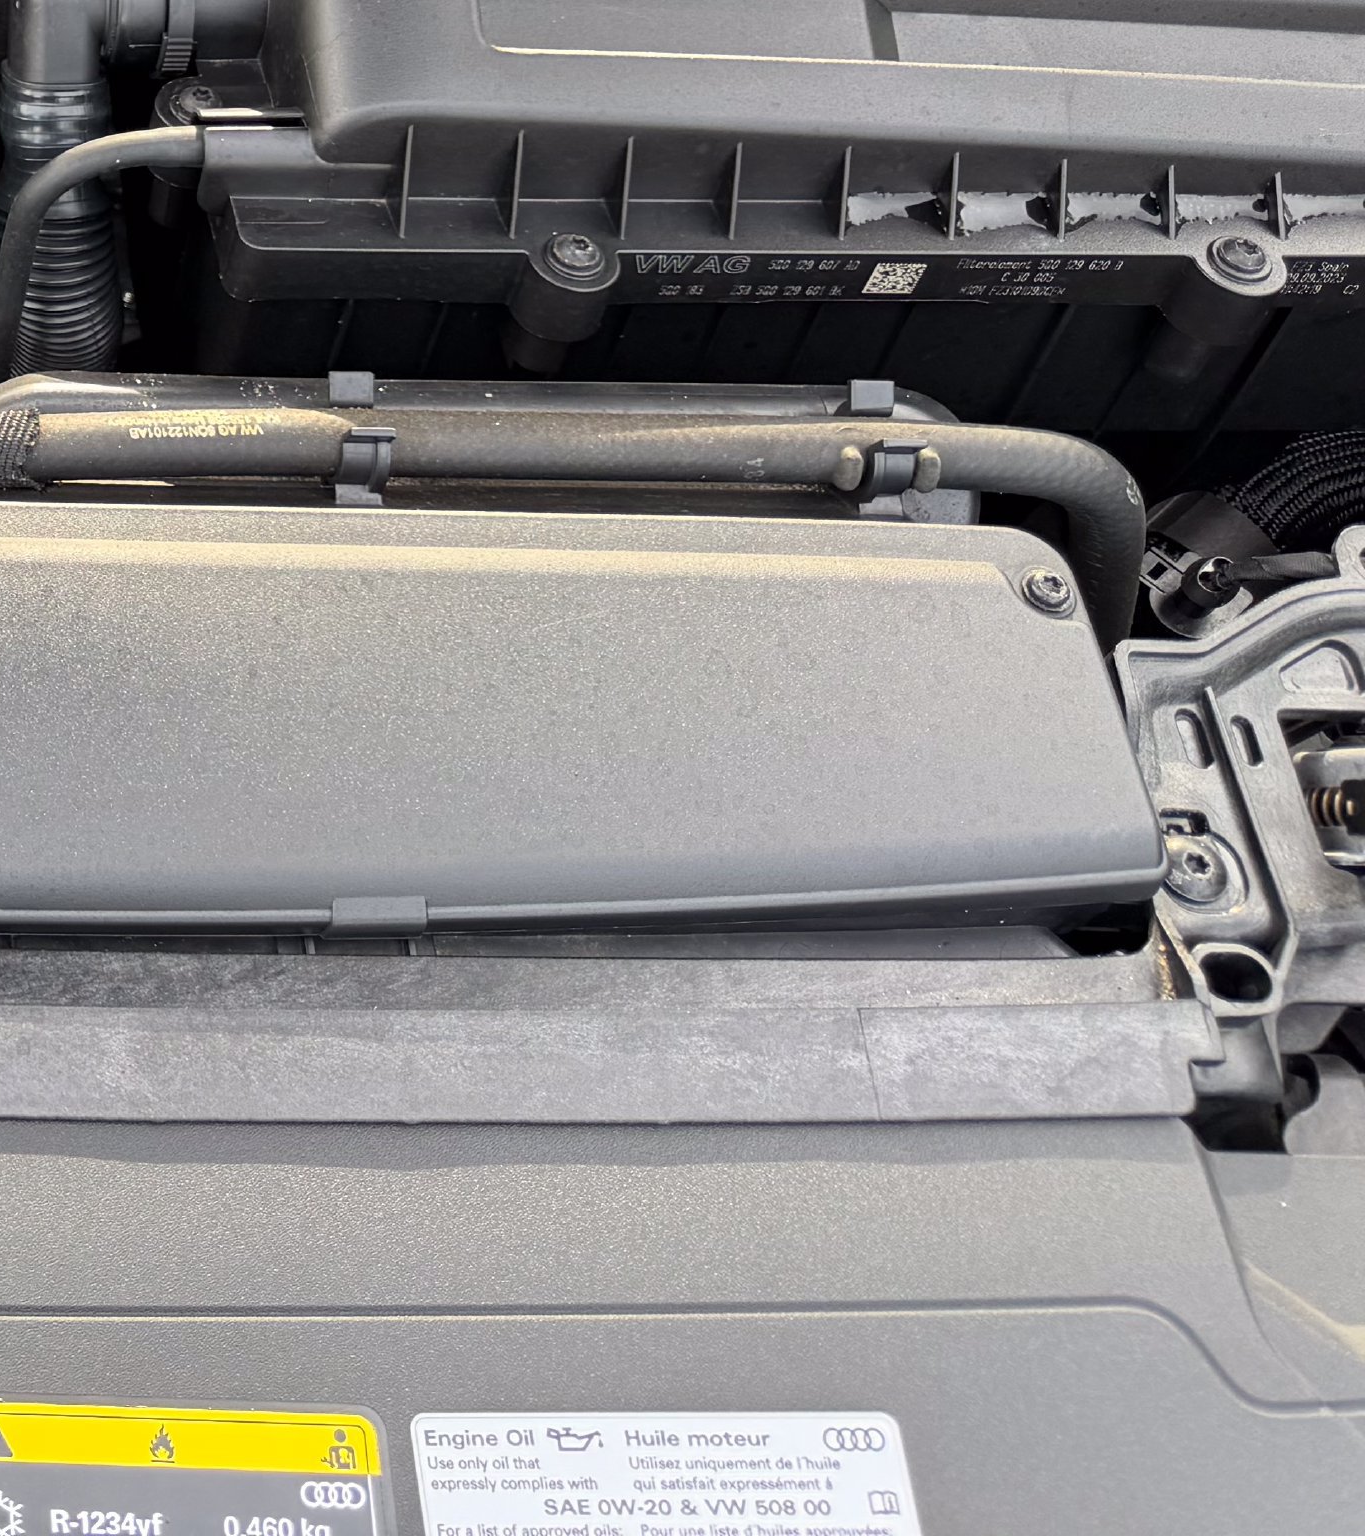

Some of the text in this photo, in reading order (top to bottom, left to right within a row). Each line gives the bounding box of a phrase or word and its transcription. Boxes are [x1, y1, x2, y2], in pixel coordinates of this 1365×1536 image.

[635, 254, 695, 274] VW
[693, 254, 751, 274] AG
[1088, 259, 1111, 271] 620
[1000, 272, 1011, 283] C
[218, 424, 237, 437] AG
[240, 423, 265, 436] VW
[423, 1429, 535, 1450] Engine Oil
[624, 1429, 770, 1447] Huile moteur
[427, 1455, 541, 1473] Use only oil that
[628, 1456, 682, 1471] Utilisez
[685, 1457, 771, 1474] uniquement
[775, 1456, 794, 1471] de
[430, 1476, 599, 1493] expressly complies with
[632, 1477, 657, 1494] qui
[660, 1477, 717, 1491] satisfait
[543, 1498, 832, 1516] SAE 0W-20 & VW 508 00
[49, 1509, 332, 1536] R-1234yf 0.460 kg
[436, 1523, 461, 1536] For
[465, 1526, 474, 1536] a
[477, 1523, 499, 1536] list
[502, 1523, 517, 1536] of
[521, 1524, 590, 1536] approved
[640, 1524, 674, 1536] Pour
[678, 1527, 704, 1536] une
[708, 1524, 741, 1536] liste
